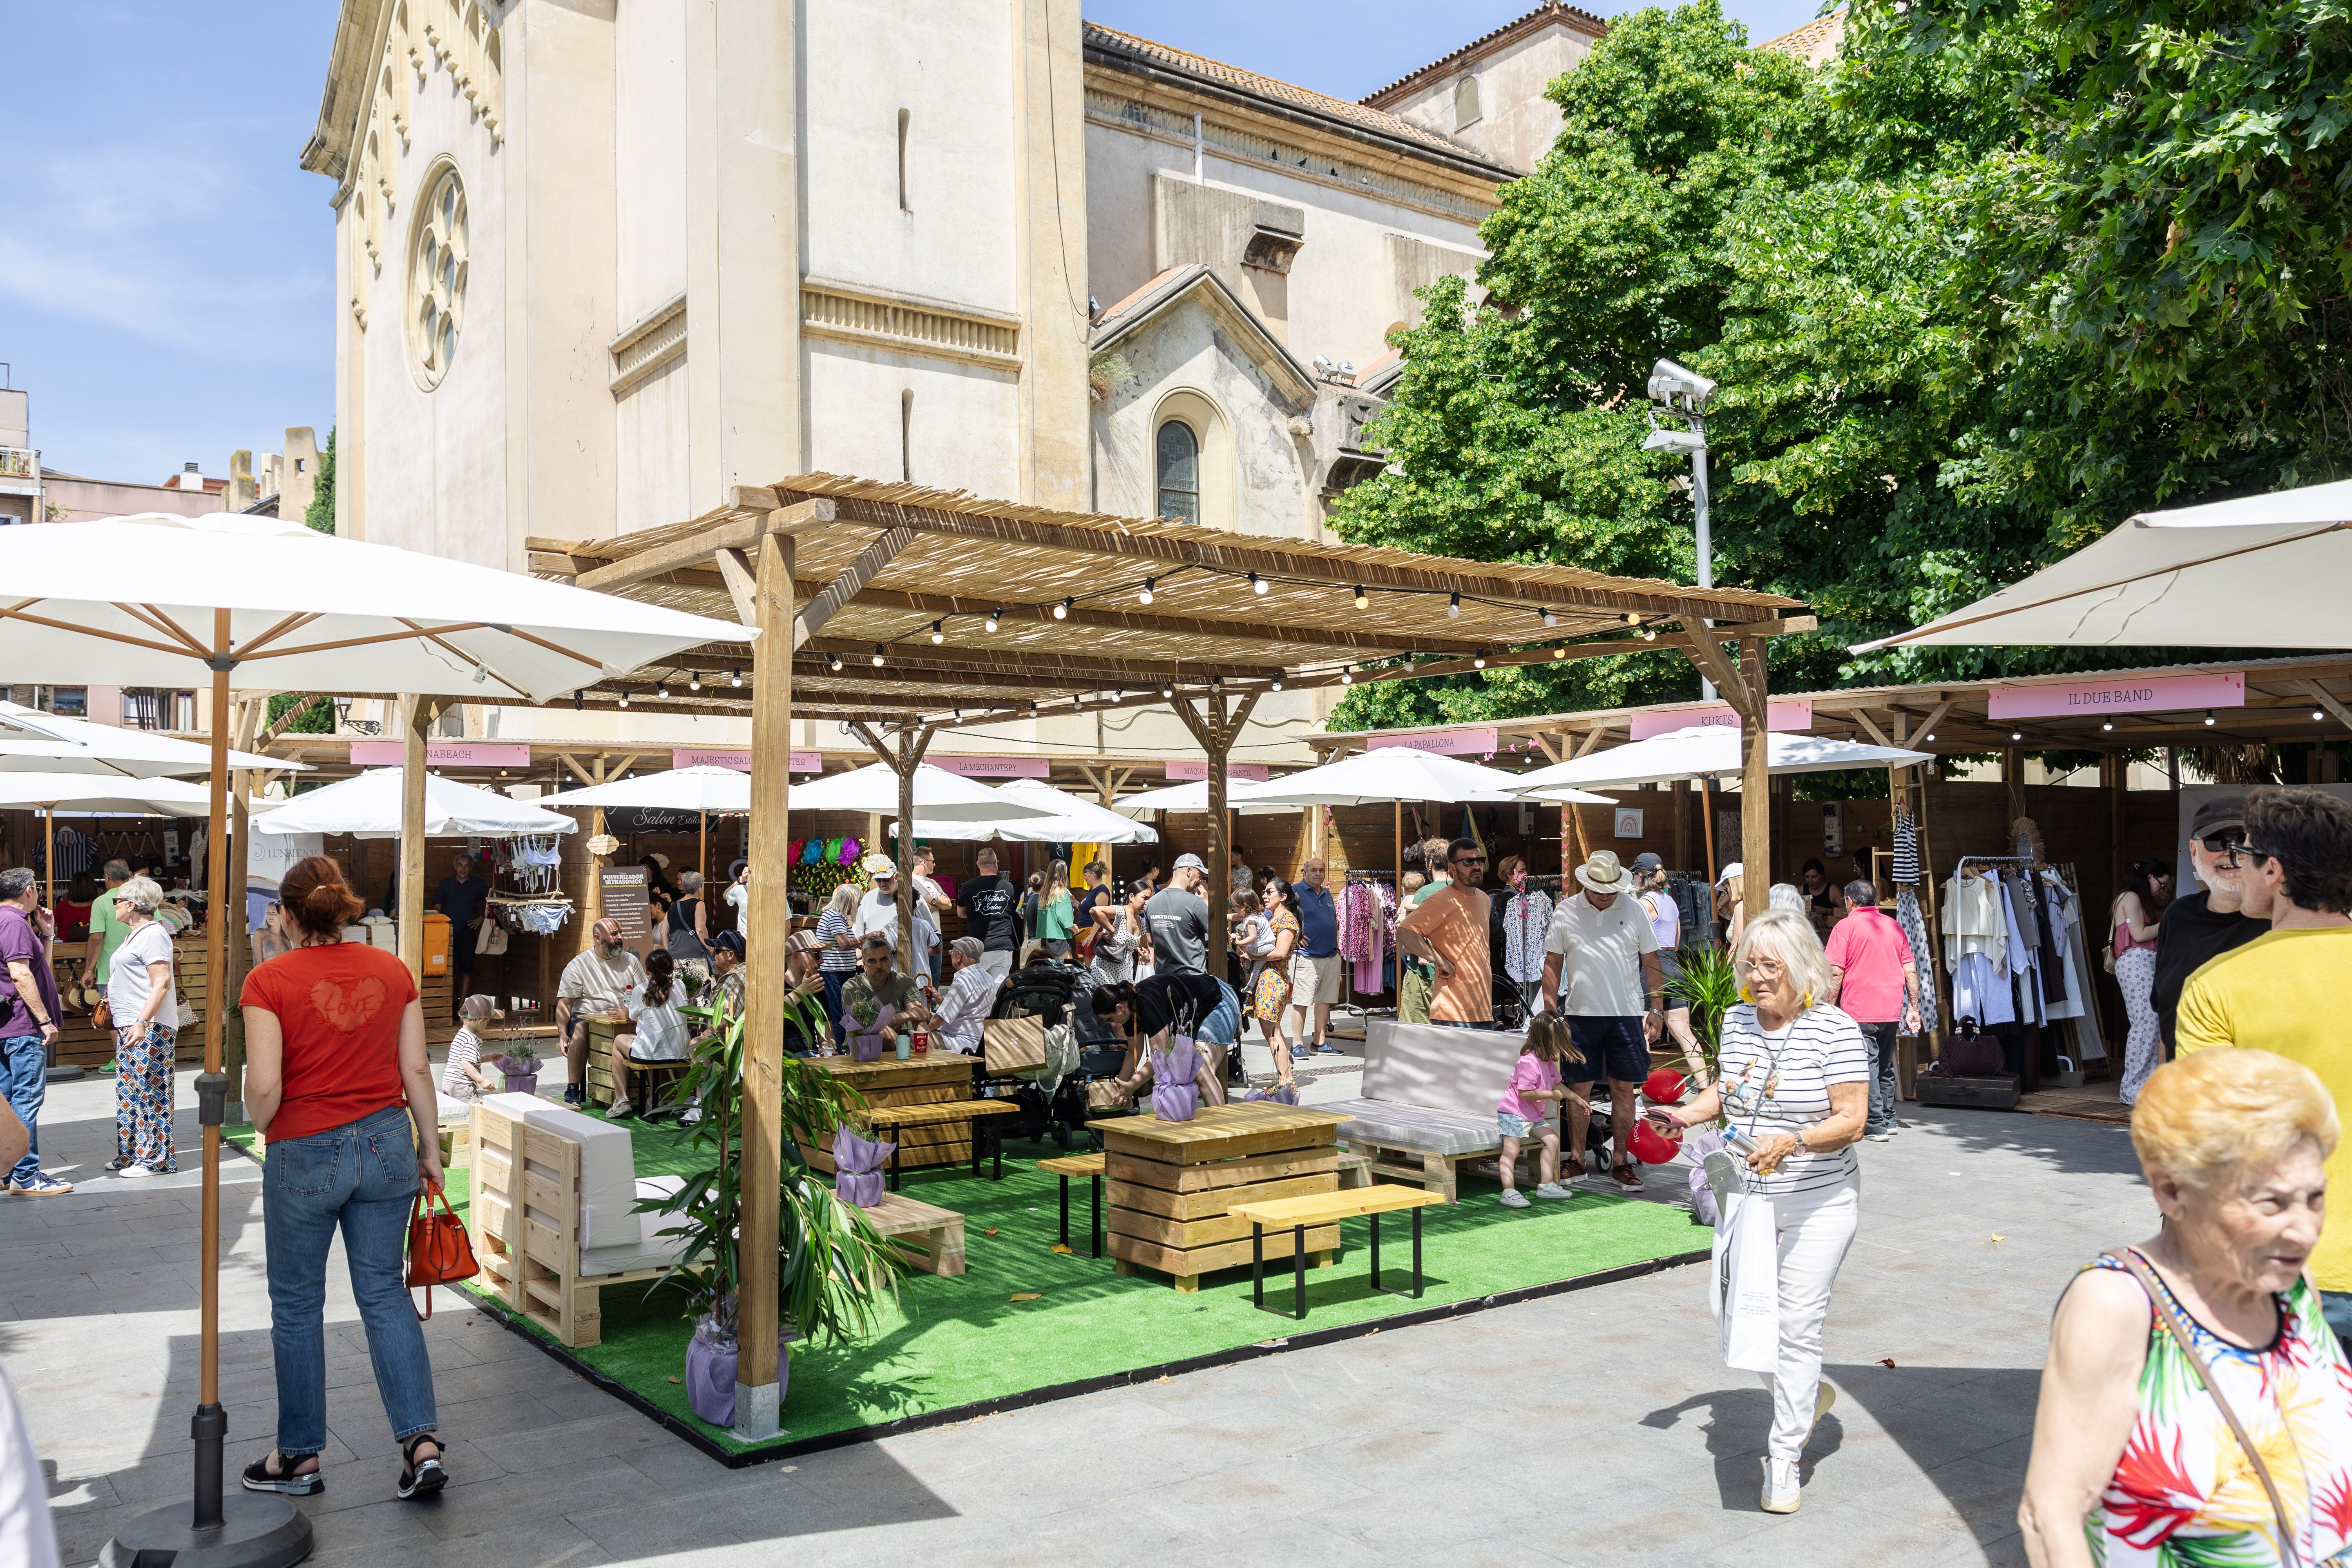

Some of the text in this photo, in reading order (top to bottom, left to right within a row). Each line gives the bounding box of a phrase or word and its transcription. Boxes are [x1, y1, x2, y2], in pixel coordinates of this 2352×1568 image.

[2068, 688, 2153, 705] IL DUE BAND
[1701, 714, 1733, 726] KUKI'S
[1414, 738, 1454, 749] PAPALLONA
[426, 750, 472, 759] NABEACH
[691, 756, 733, 764] MAJESTIC
[969, 762, 1017, 771] MÉCHANTERY
[633, 806, 676, 826] Salon
[677, 815, 709, 826] Estiliss
[268, 849, 317, 858] LUNABEACH
[324, 991, 375, 1014] LOVE
